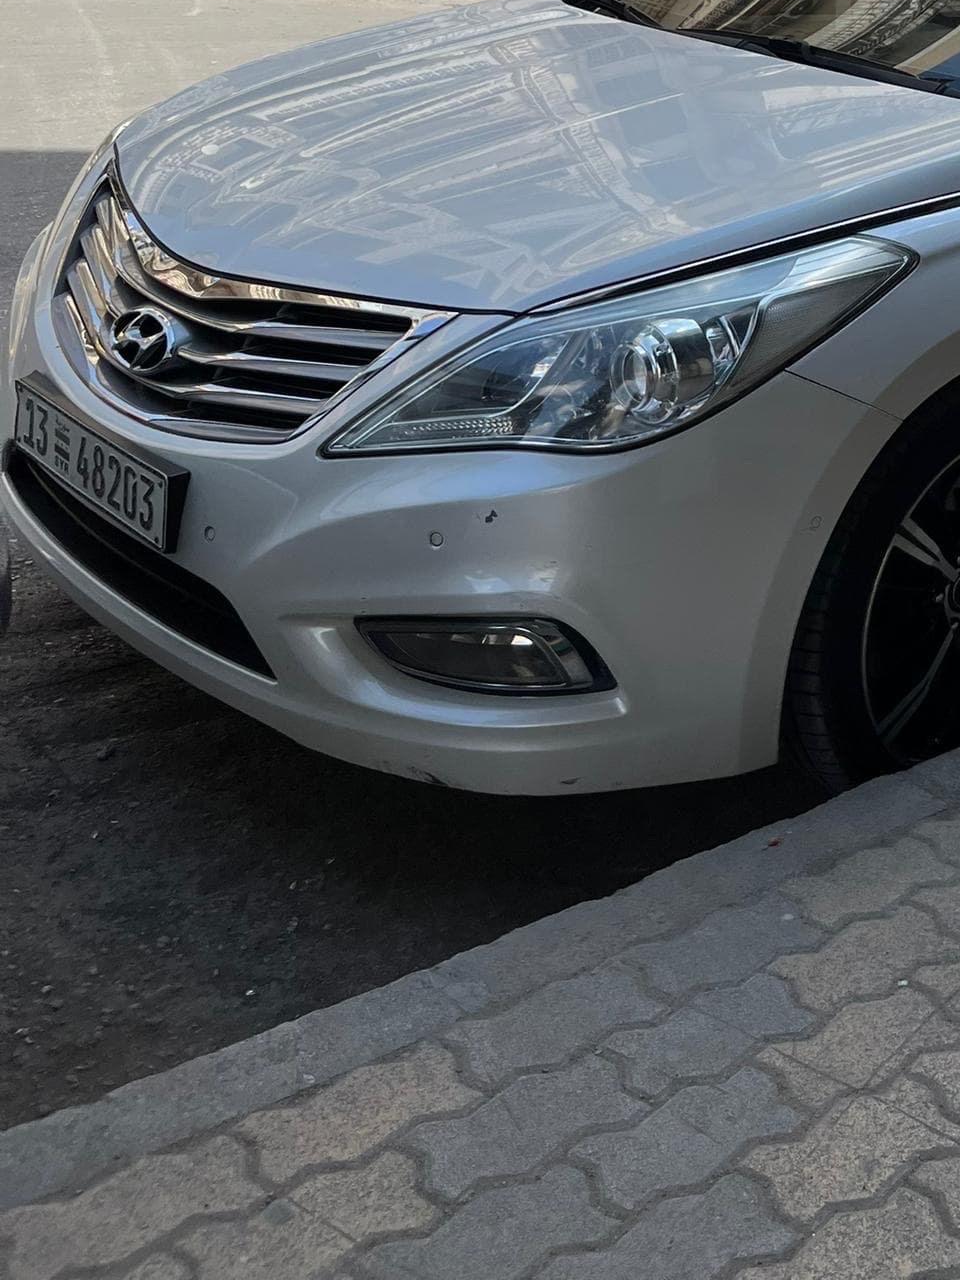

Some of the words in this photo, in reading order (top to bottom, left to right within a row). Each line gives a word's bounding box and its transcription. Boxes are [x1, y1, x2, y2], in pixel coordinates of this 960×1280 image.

[23, 397, 49, 457] 13
[54, 454, 70, 476] SYR
[76, 436, 155, 531] 48203
